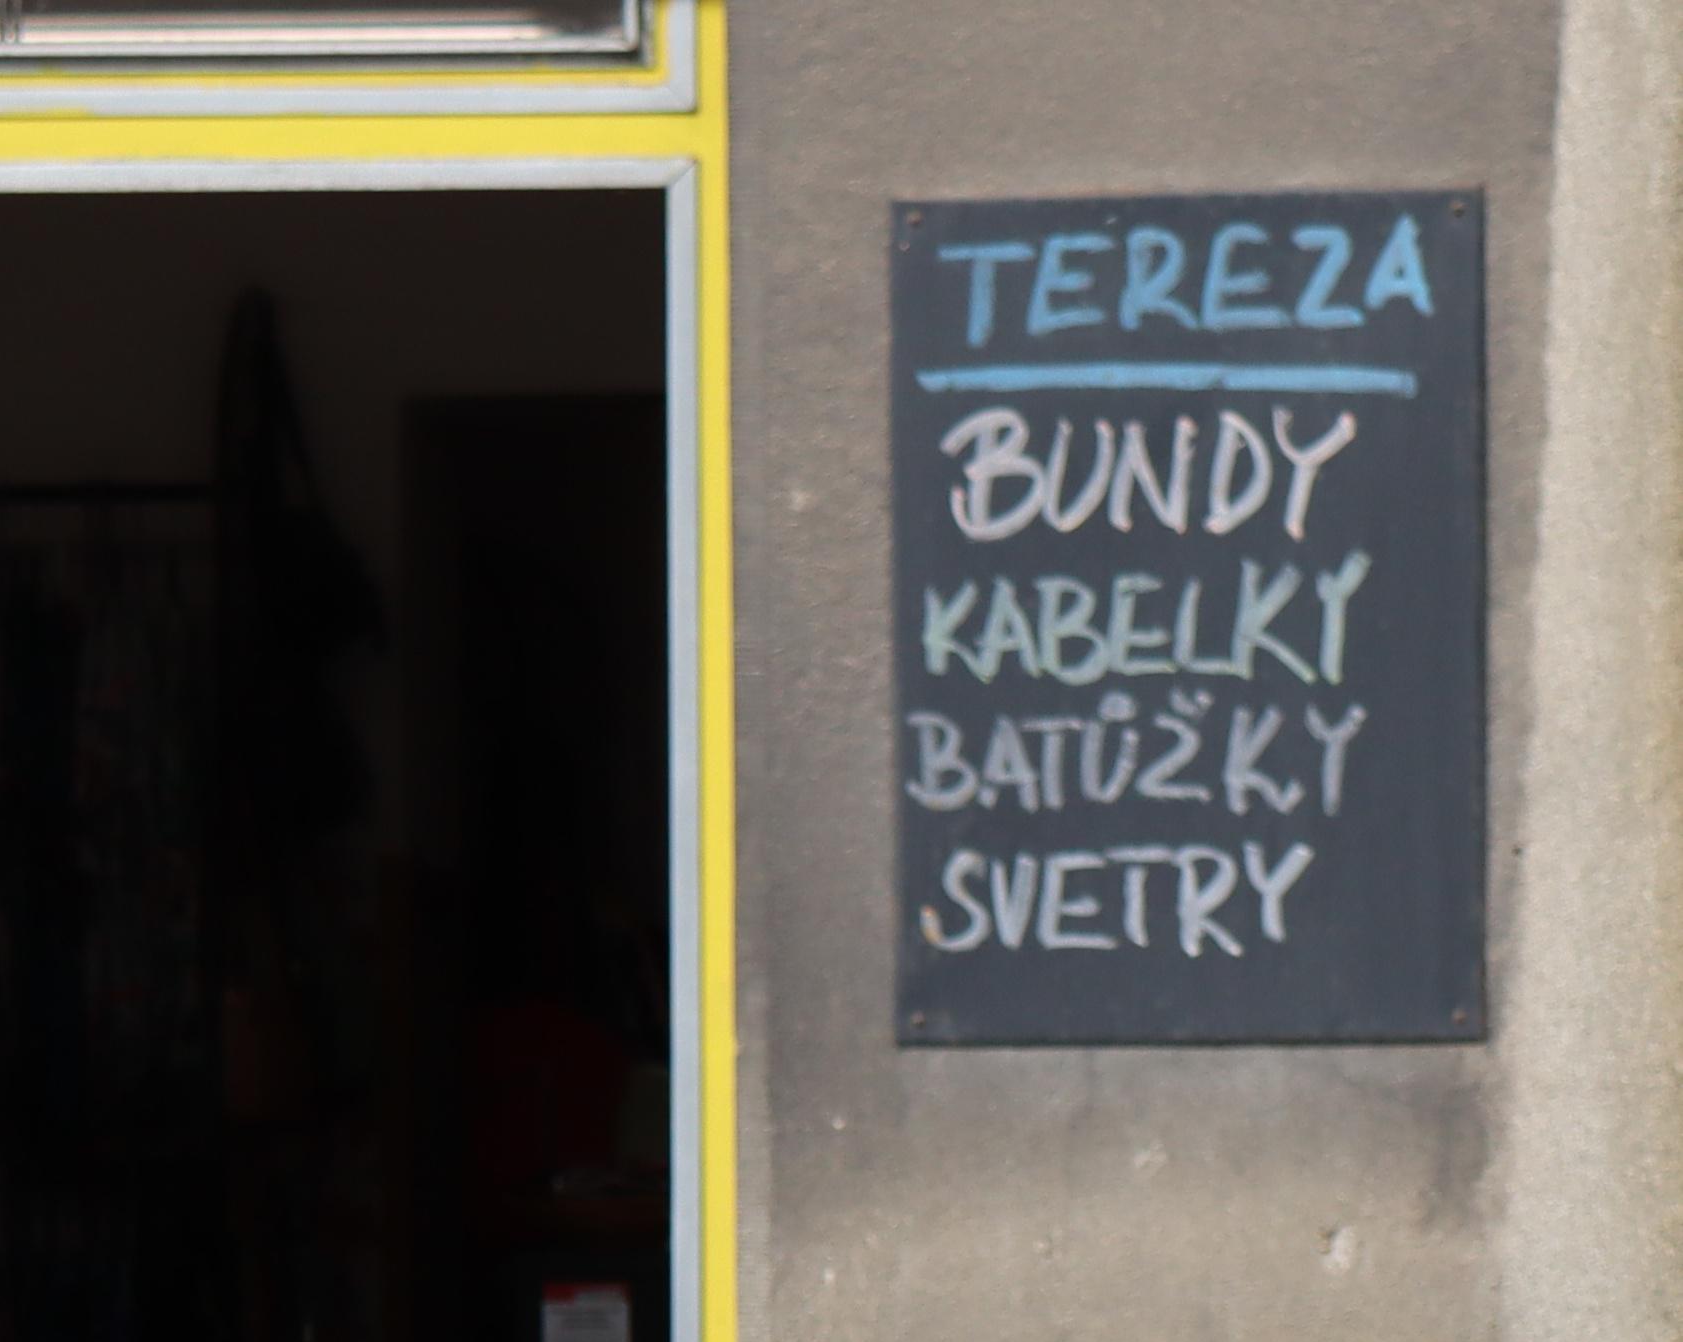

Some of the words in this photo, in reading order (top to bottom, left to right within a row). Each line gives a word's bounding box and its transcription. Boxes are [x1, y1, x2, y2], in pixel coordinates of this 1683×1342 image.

[937, 213, 1433, 348] TEREZA
[939, 405, 1358, 543] BUNDY
[921, 549, 1372, 686] KABELKY
[906, 688, 1368, 817] BATŮŽKY
[920, 841, 1314, 958] SVETRY
